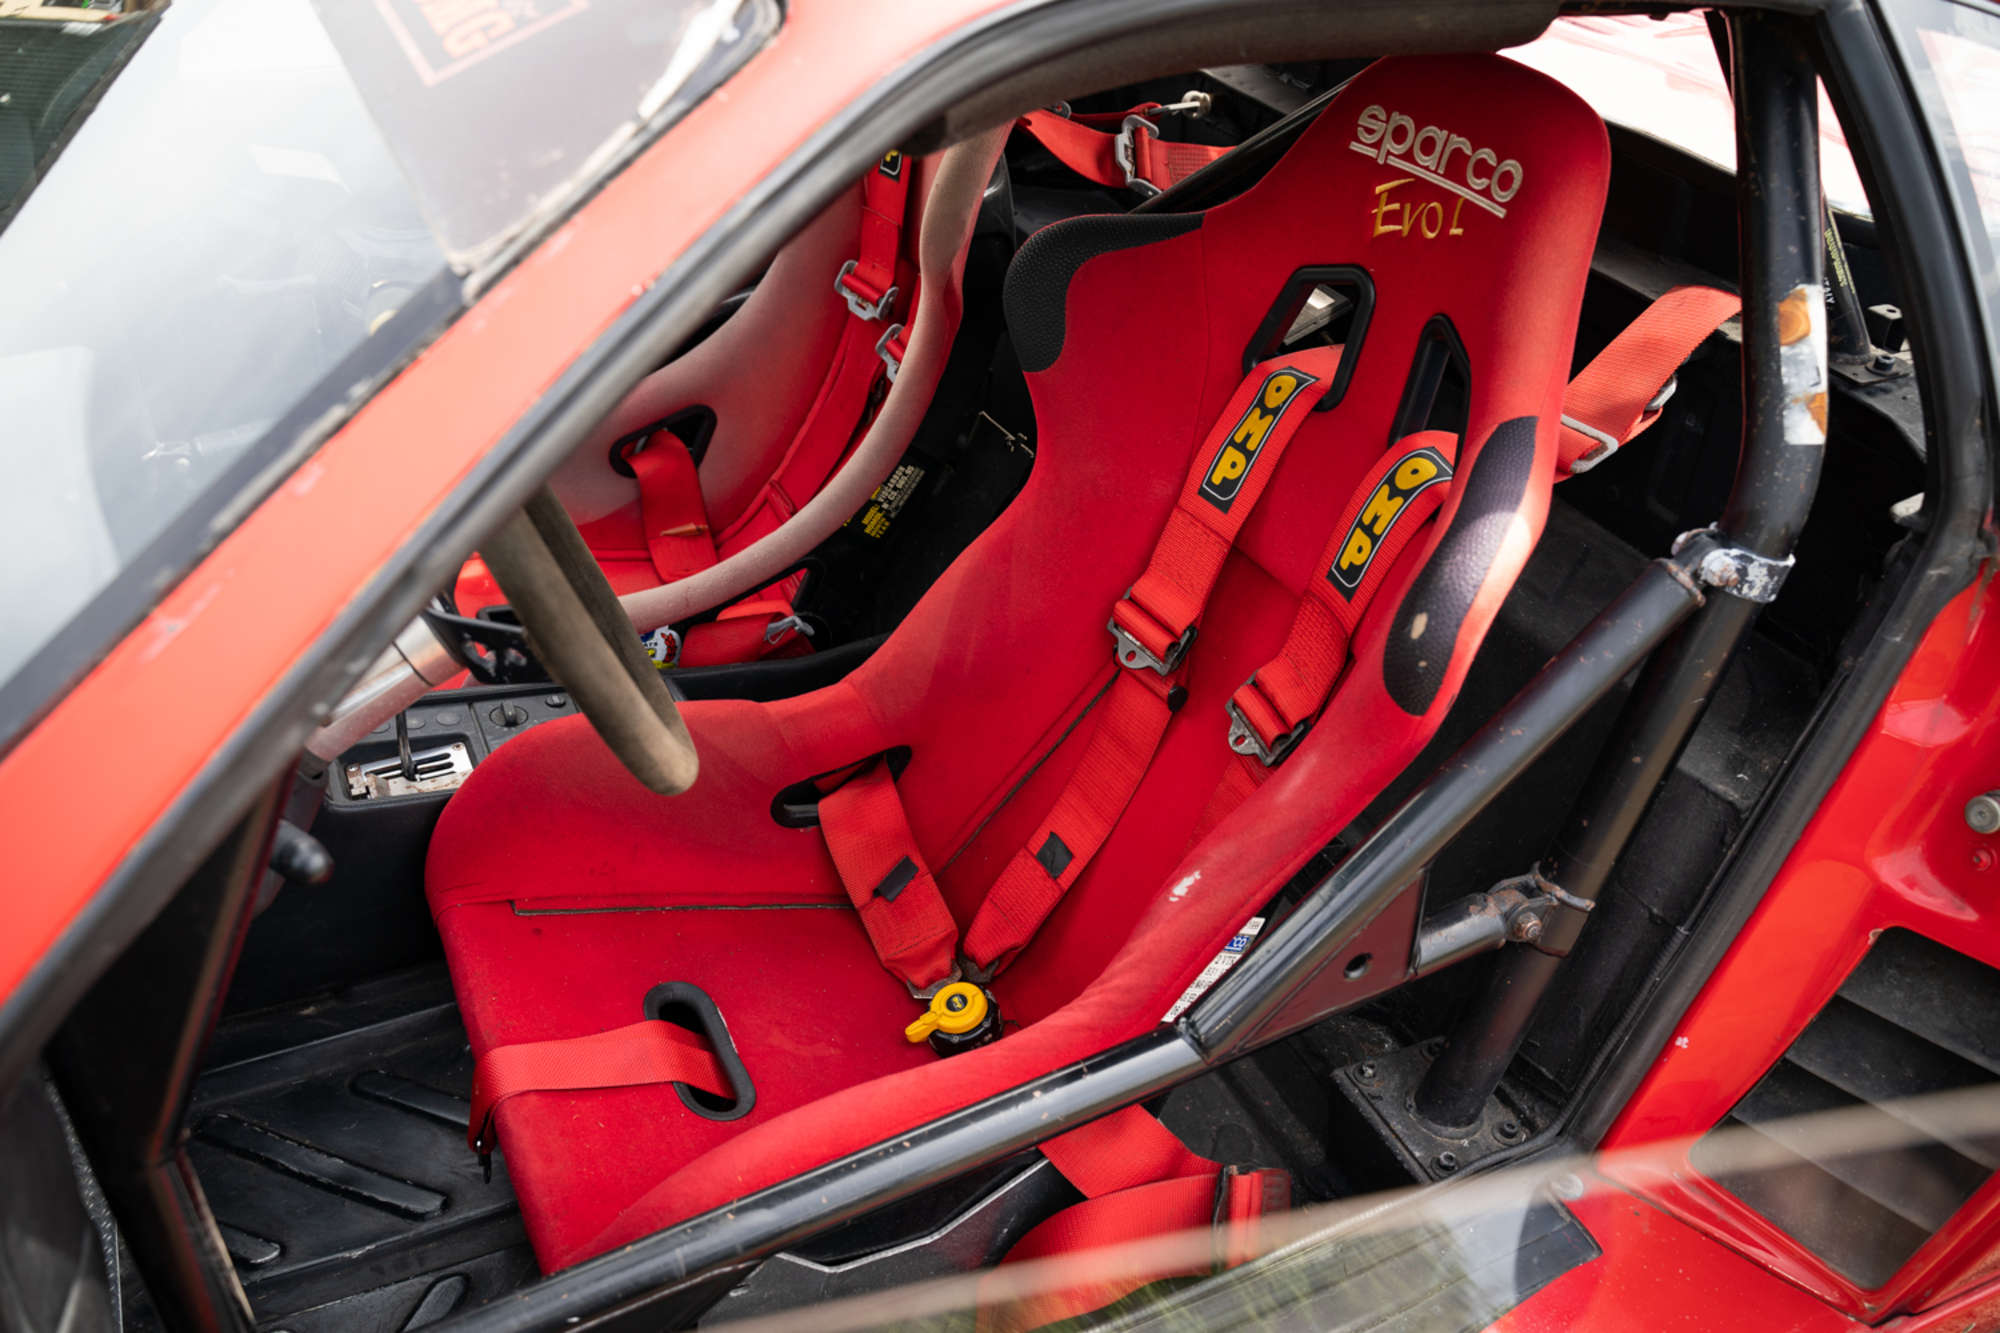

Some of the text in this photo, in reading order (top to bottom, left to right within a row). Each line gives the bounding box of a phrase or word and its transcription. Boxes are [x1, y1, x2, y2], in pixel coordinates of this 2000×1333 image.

[1356, 104, 1523, 203] sparco
[1211, 374, 1297, 486] OMP
[1339, 456, 1438, 571] OMP
